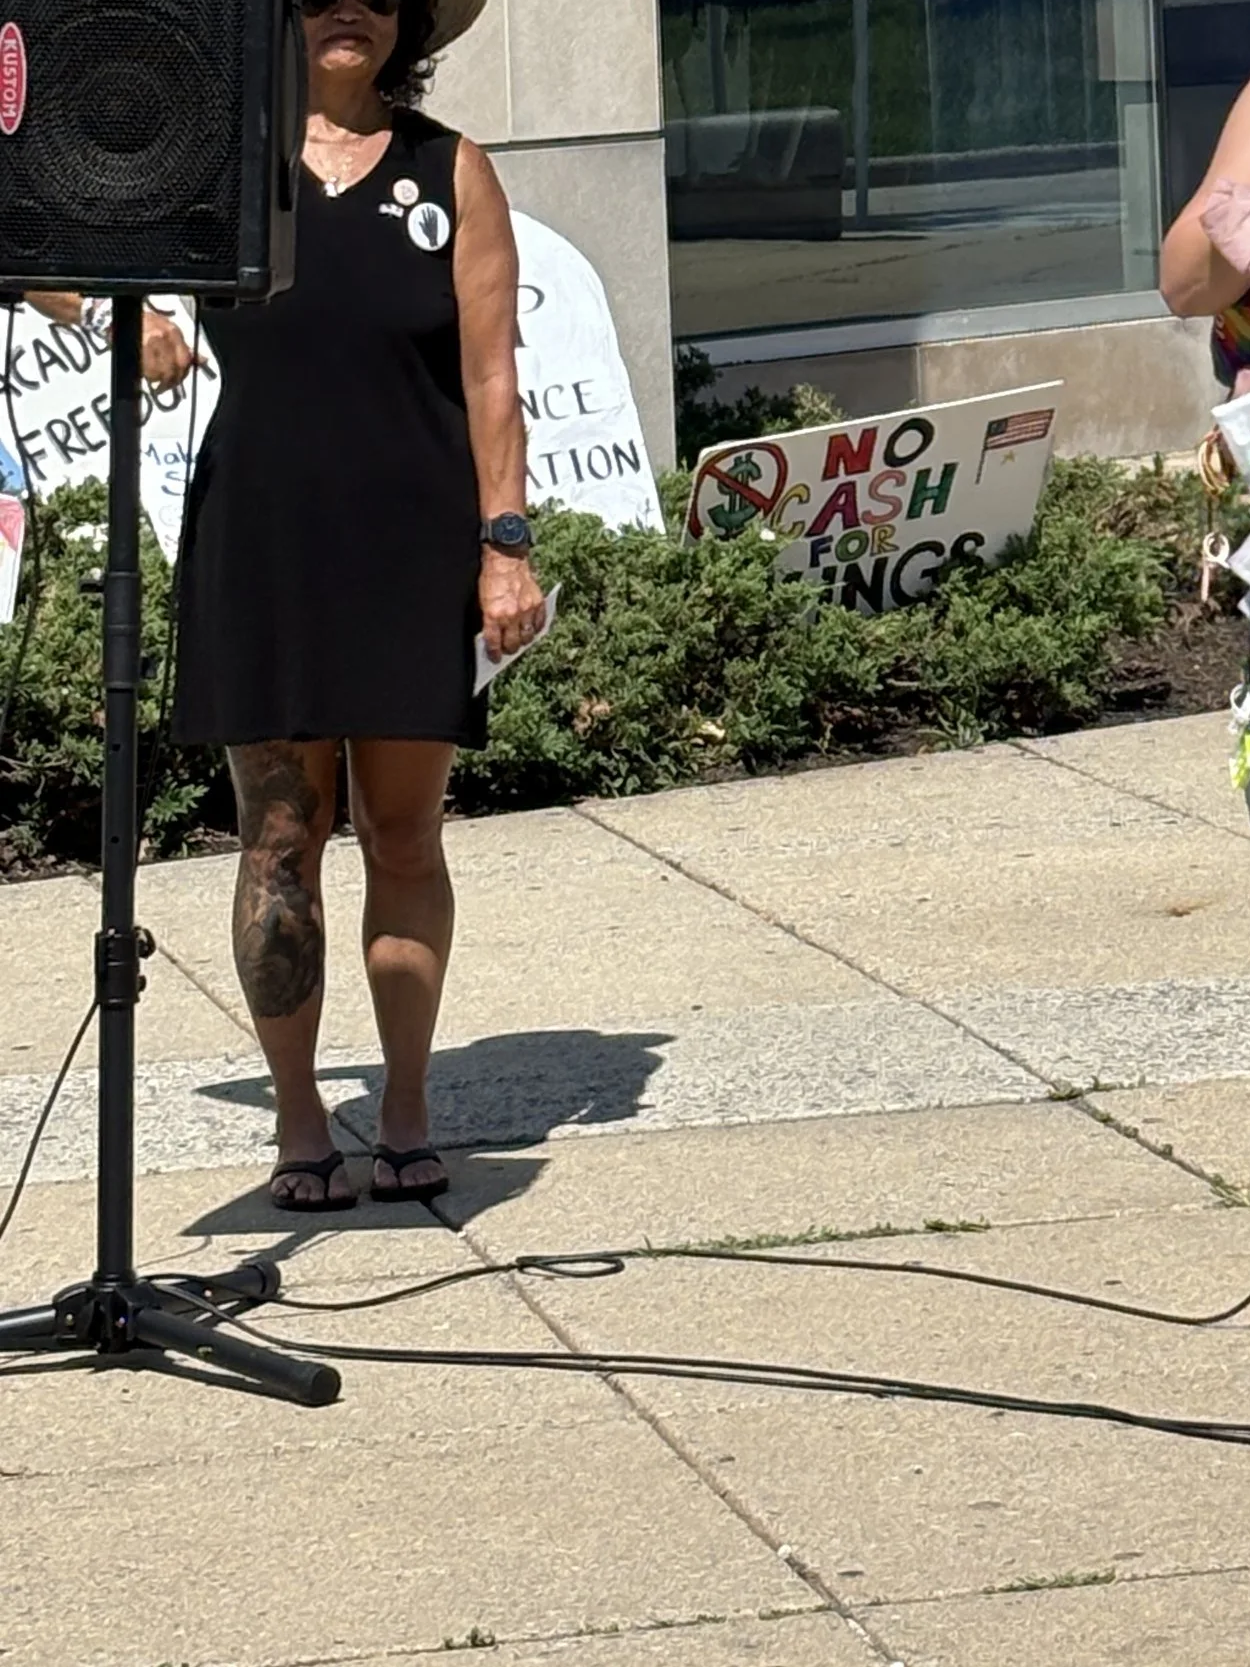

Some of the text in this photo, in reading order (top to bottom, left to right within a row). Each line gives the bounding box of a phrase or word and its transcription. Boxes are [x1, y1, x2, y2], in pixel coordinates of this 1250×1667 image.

[3, 38, 18, 118] KUSTOM
[517, 379, 603, 421] NCE
[821, 416, 935, 481] NO
[769, 462, 960, 538] CASH
[782, 531, 986, 624] INGS
[809, 522, 899, 568] FOR
